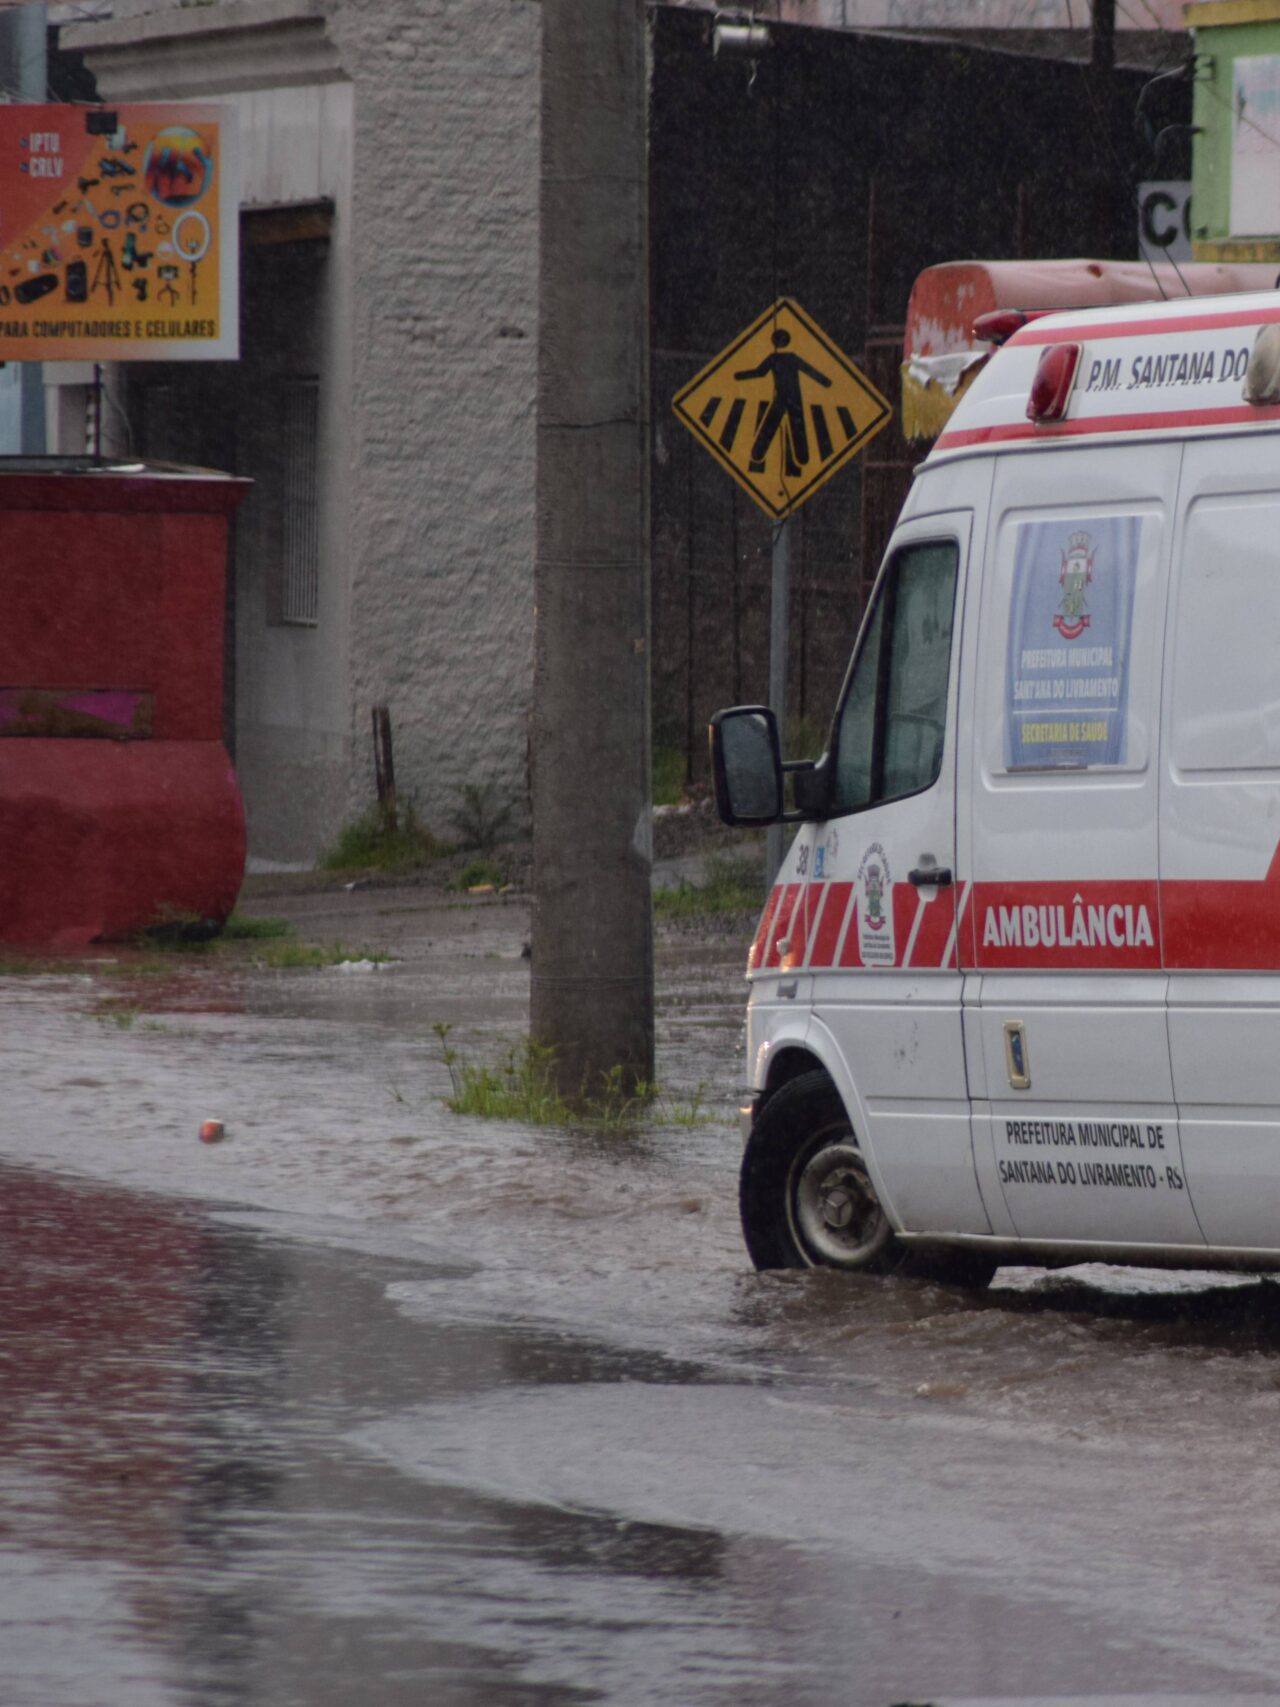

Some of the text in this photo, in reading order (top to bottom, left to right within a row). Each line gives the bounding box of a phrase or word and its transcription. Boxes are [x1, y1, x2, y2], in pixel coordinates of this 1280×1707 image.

[30, 132, 60, 153] IPTU
[30, 156, 64, 178] CRLV
[32, 320, 131, 338] COMPUTADORES
[135, 320, 142, 338] E
[146, 319, 215, 338] CELULARES
[1085, 358, 1124, 393] P.M.
[1126, 351, 1216, 391] SANTANA
[1217, 346, 1250, 384] DO
[1022, 646, 1113, 669] PREFEITURA MUNICIPAL
[1053, 680, 1064, 699] DO
[1066, 677, 1118, 698] LIVRAMENTO
[1022, 722, 1067, 744] SECRETARIA
[1069, 722, 1079, 743] DE
[983, 893, 1154, 947] AMBULÂNCIA
[1006, 1121, 1165, 1149] PREFEITURA MUNICIPAL DE
[1000, 1160, 1056, 1185] SANTANA
[1056, 1161, 1076, 1185] DO
[1078, 1163, 1156, 1188] LIVRAMENTO
[1166, 1166, 1184, 1190] RS
